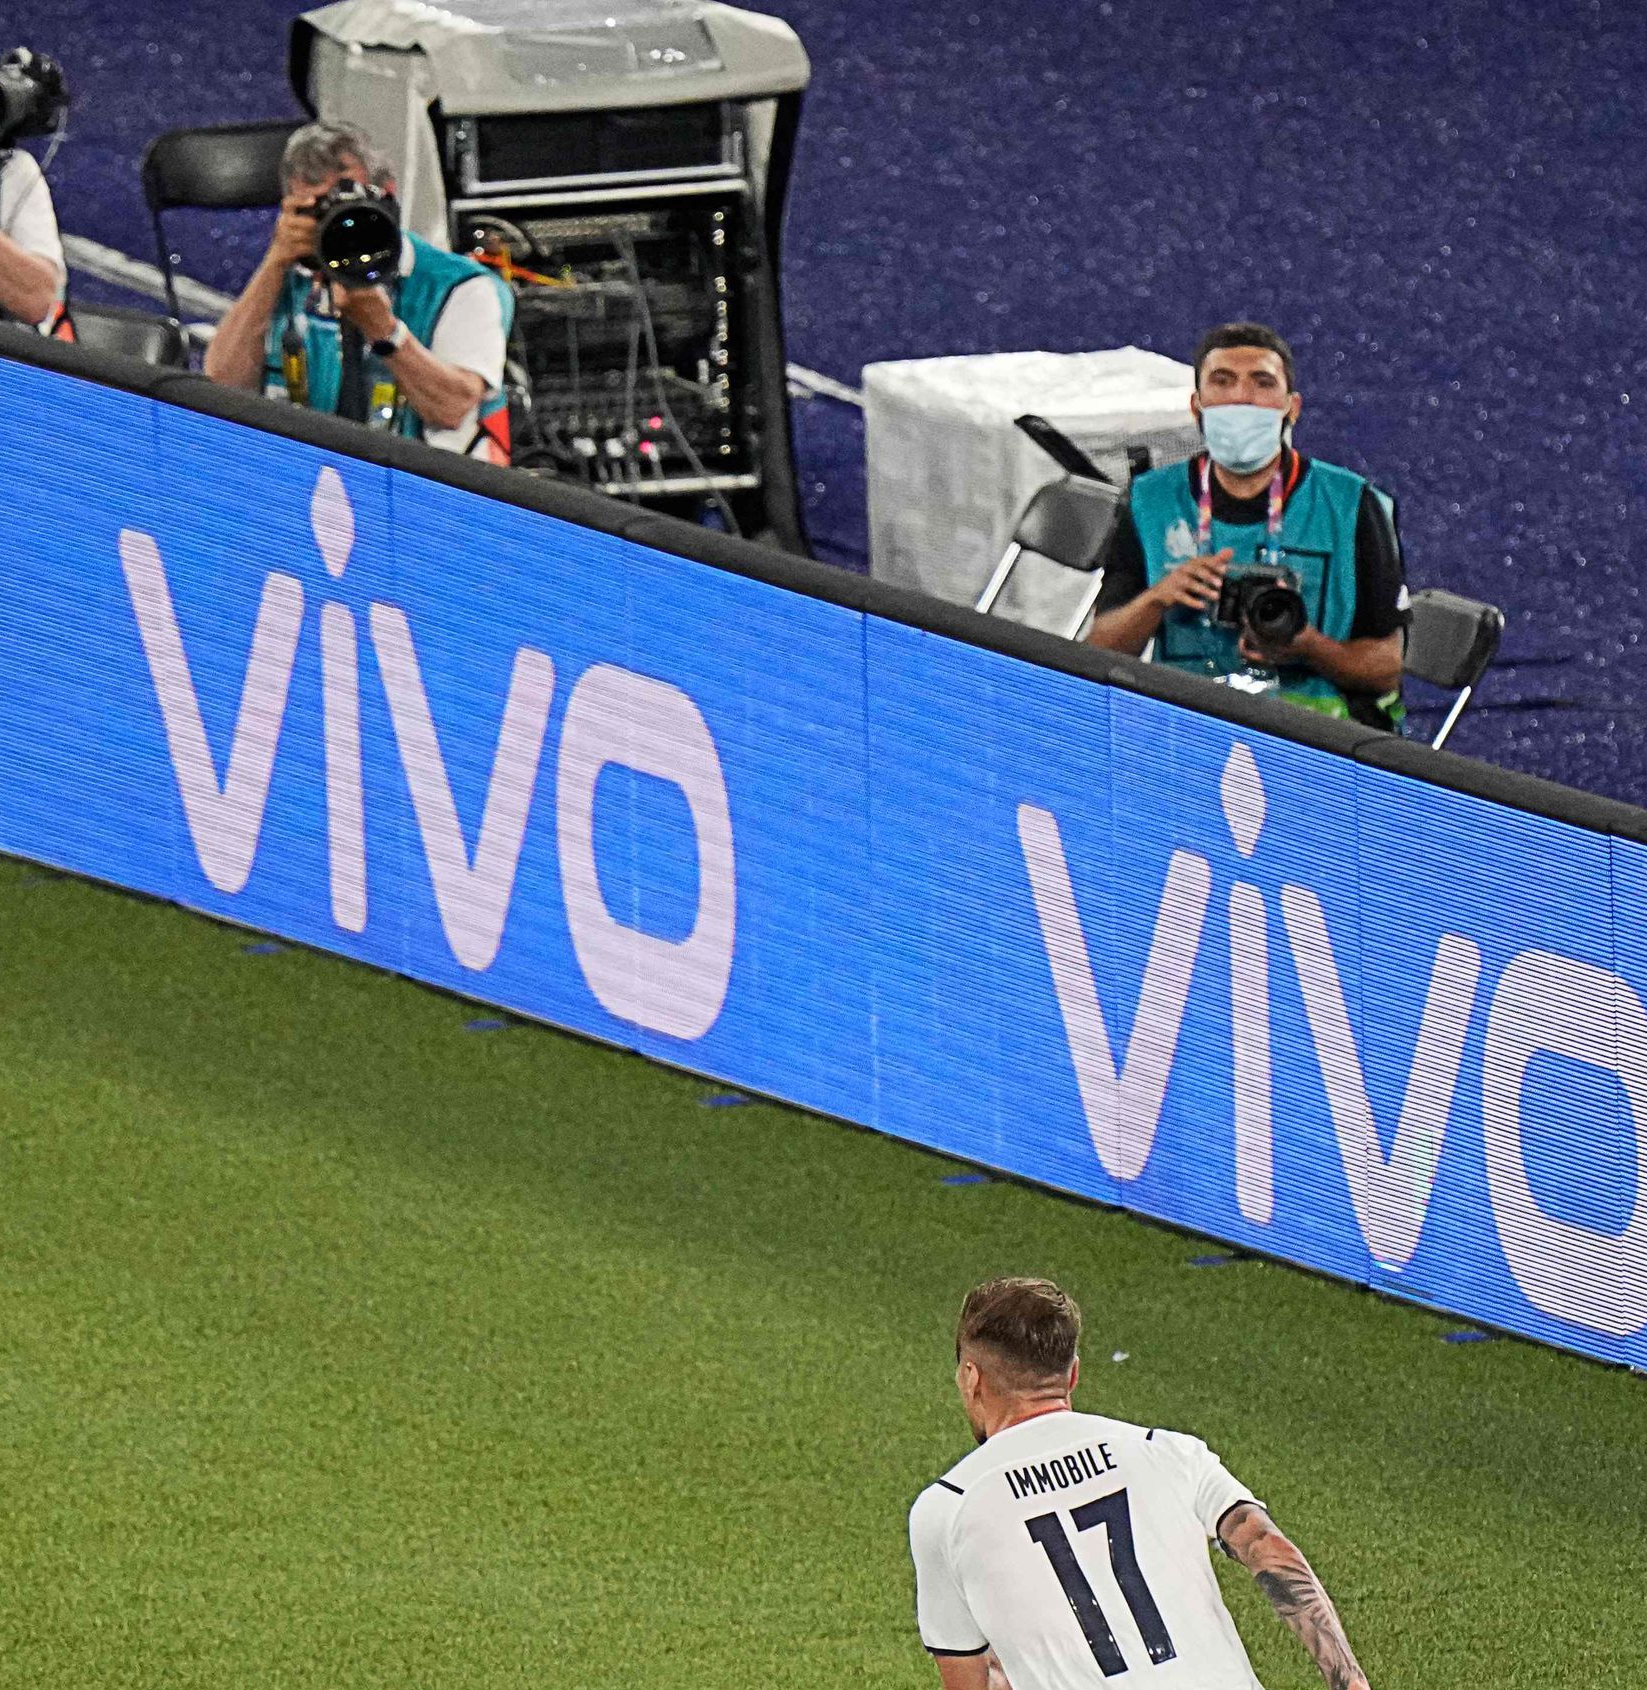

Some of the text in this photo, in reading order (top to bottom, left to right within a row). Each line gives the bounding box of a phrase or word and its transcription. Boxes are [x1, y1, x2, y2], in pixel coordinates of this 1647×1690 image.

[119, 466, 737, 1041] vivo
[1004, 1442, 1118, 1500] IMMOBILE
[1024, 1487, 1178, 1678] 17
